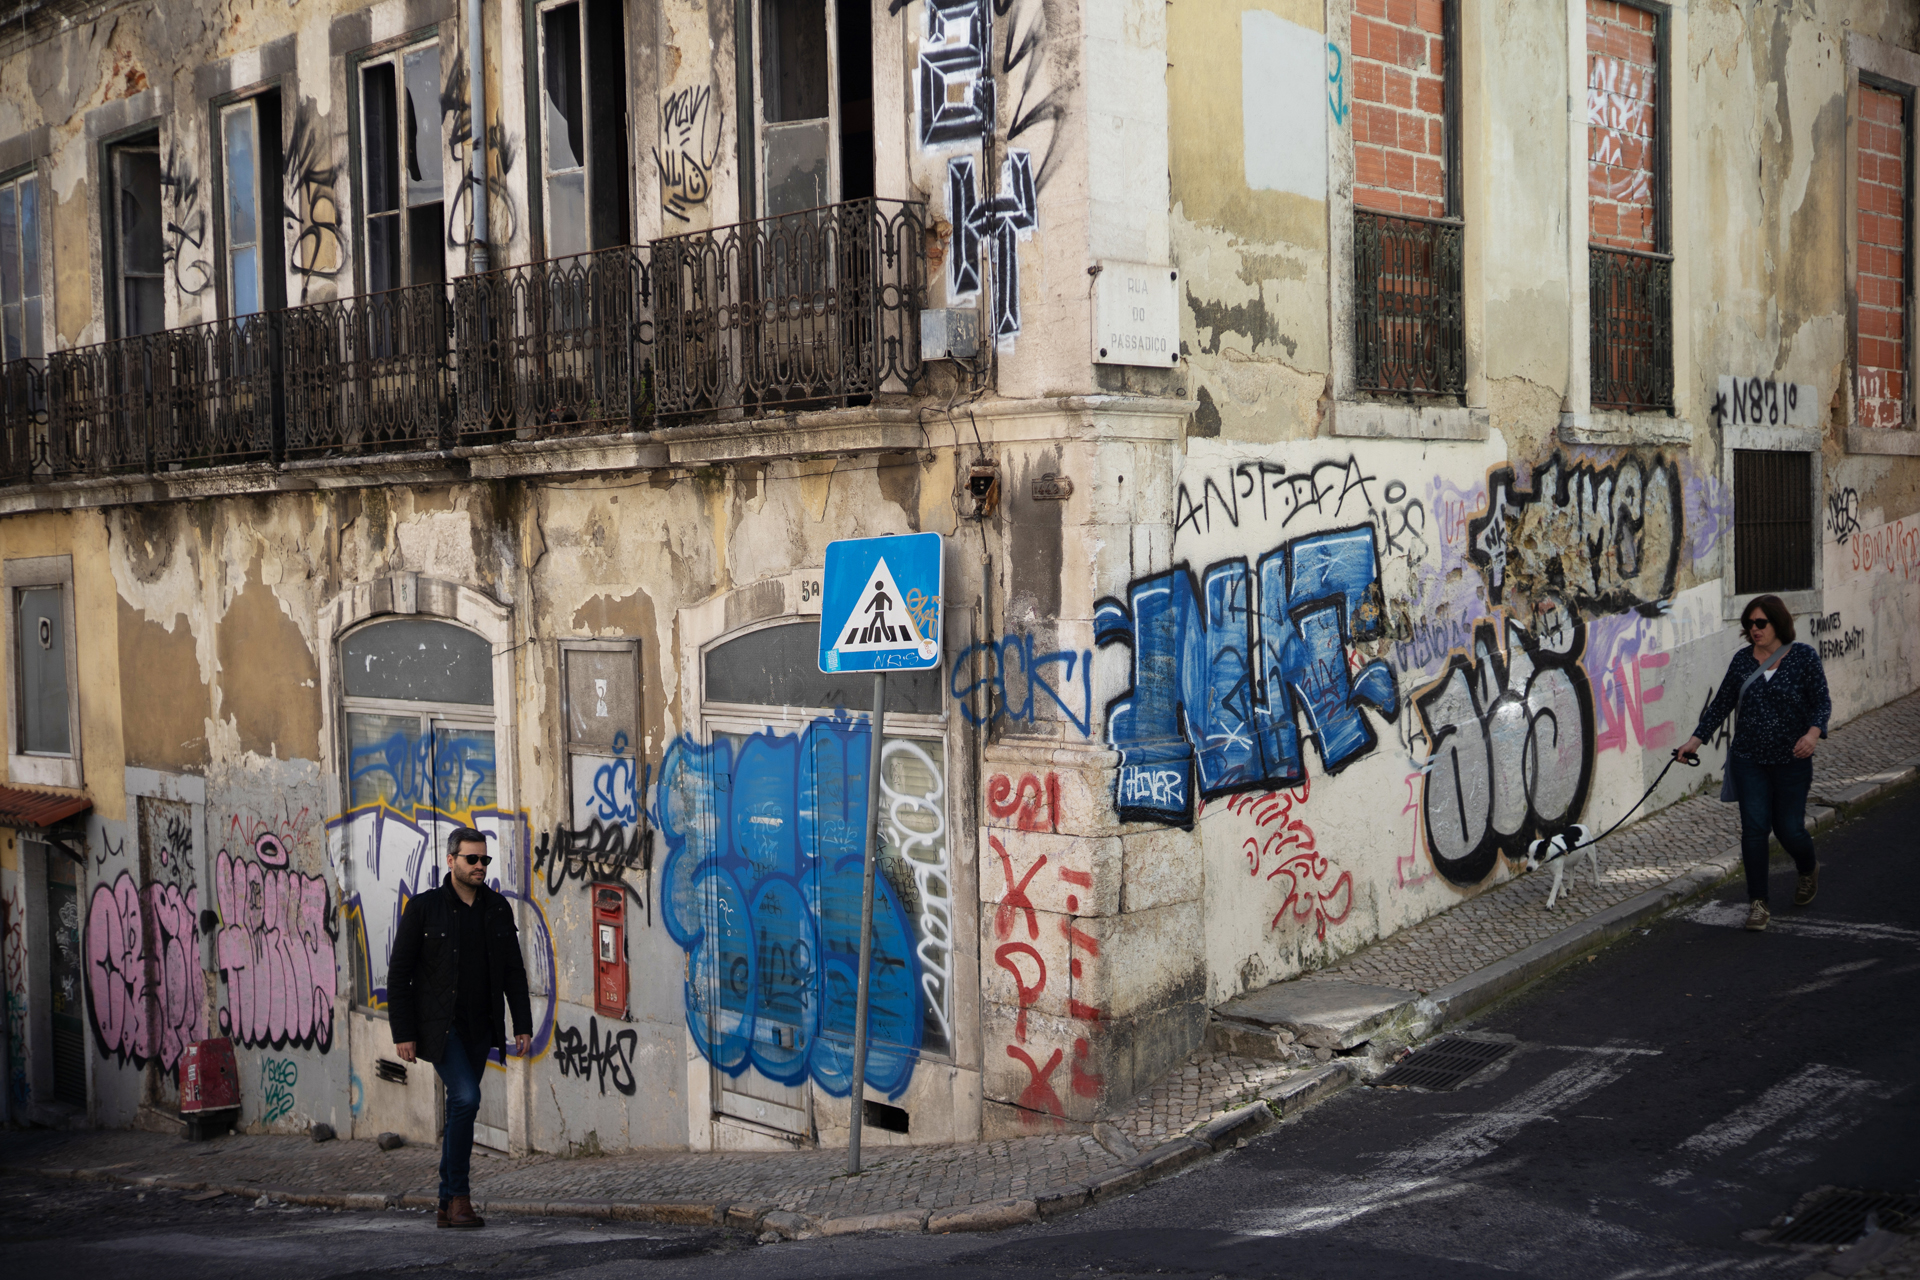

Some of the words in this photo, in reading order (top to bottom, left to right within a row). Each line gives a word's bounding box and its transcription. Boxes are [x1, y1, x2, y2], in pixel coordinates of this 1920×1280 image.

[1127, 277, 1148, 295] RUA
[1132, 306, 1145, 322] DO
[1111, 333, 1167, 352] PASSADIÇO
[801, 580, 820, 602] 5A
[1819, 638, 1845, 660] BEFORE
[553, 1015, 638, 1097] FREAKS
